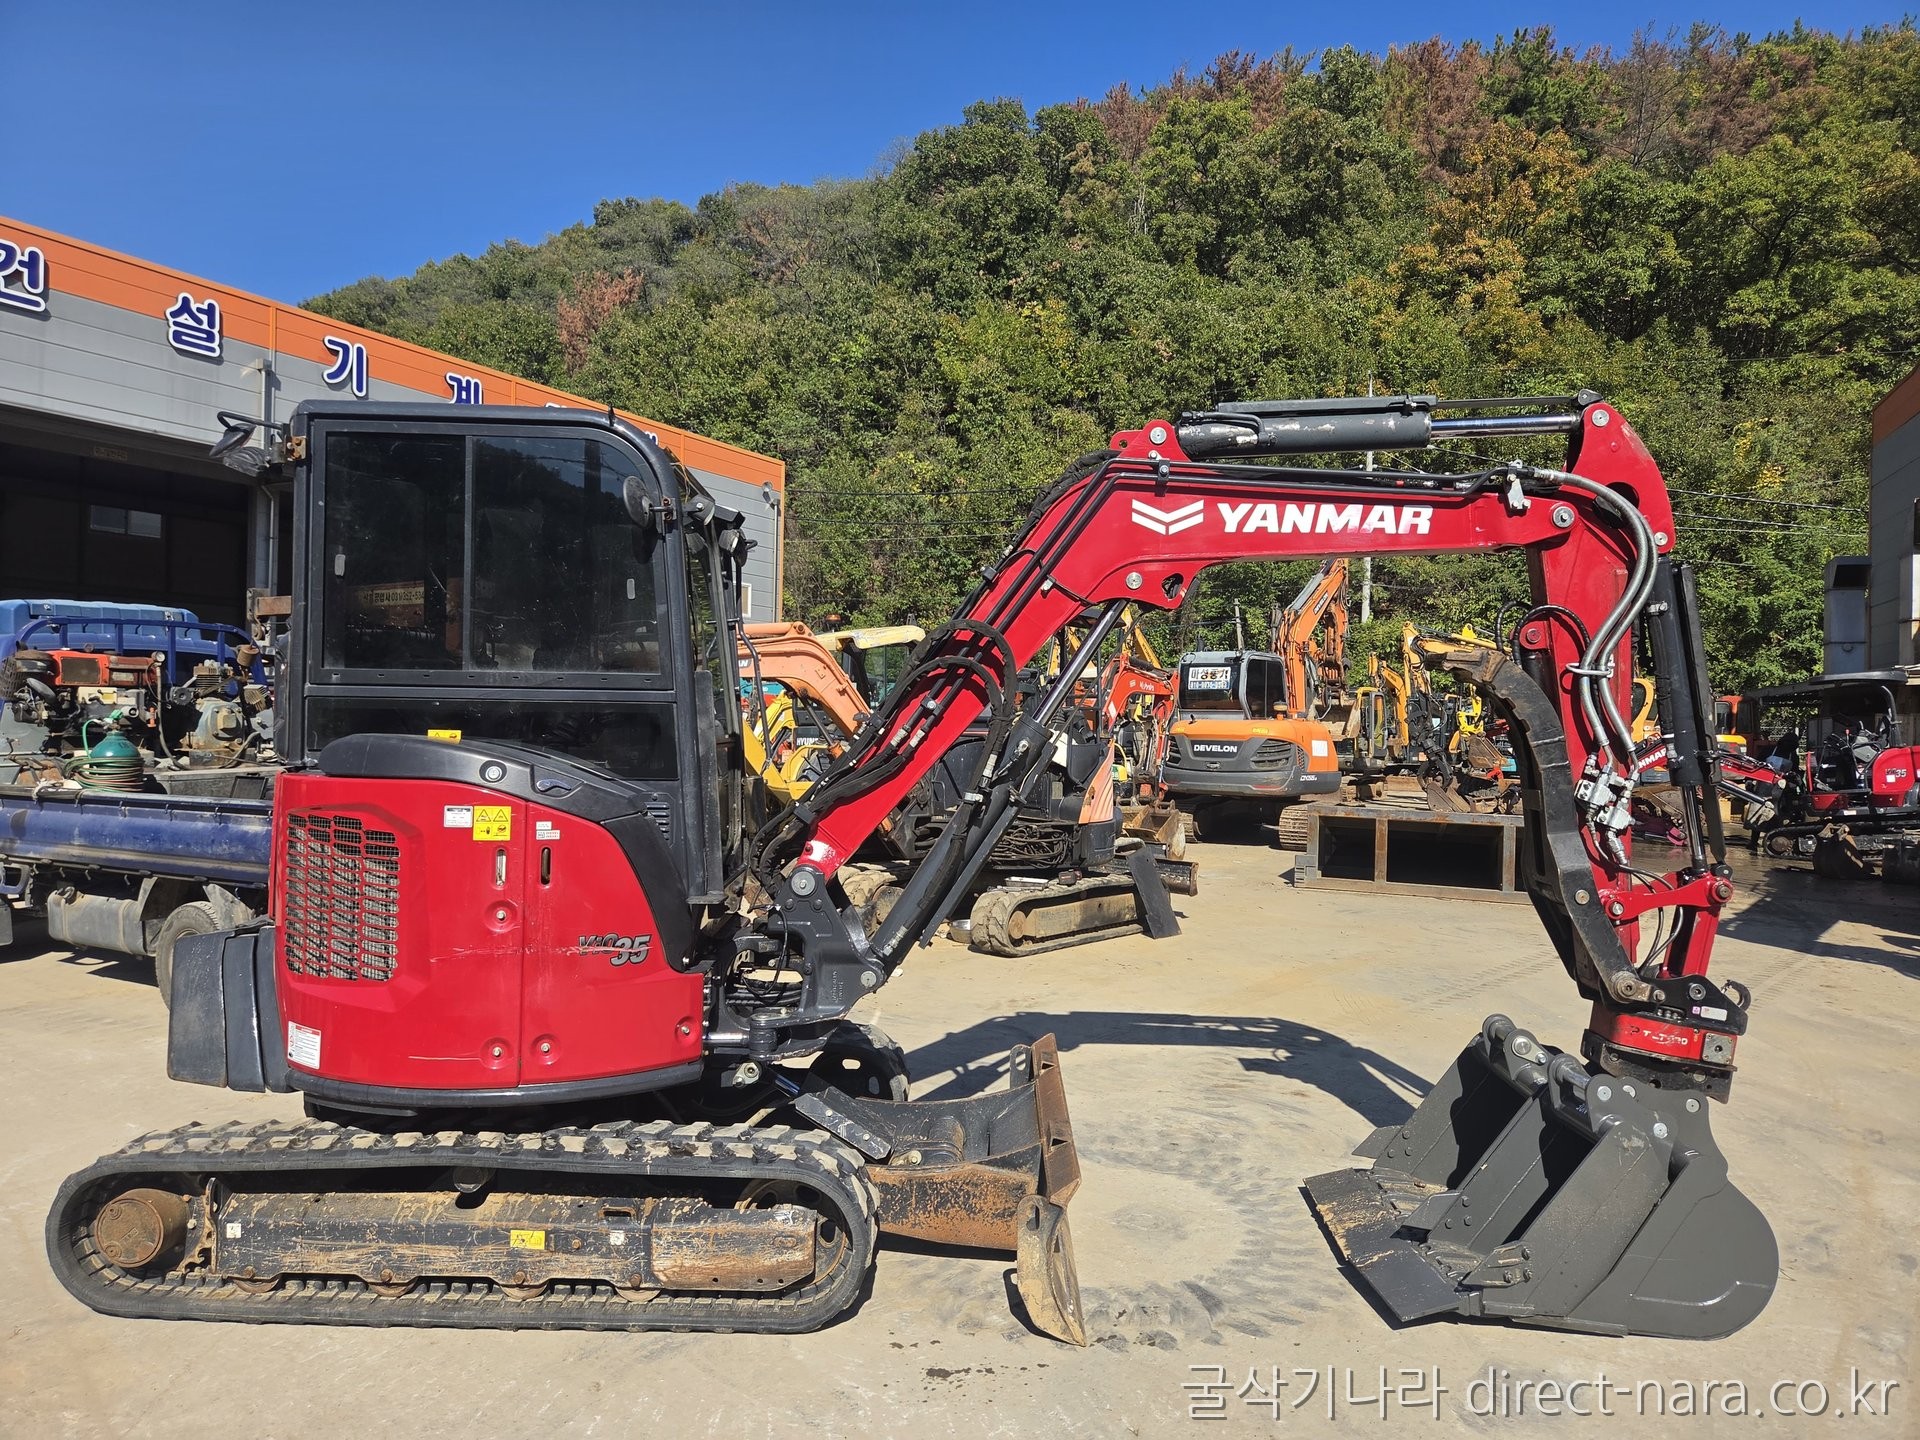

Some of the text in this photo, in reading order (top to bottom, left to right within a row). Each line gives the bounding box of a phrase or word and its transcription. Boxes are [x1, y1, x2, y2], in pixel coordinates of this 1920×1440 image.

[0, 239, 47, 313] 건
[165, 292, 222, 358] 설
[323, 335, 369, 398] 기
[1217, 502, 1434, 535] YANMAR
[1193, 744, 1238, 753] DEVELON
